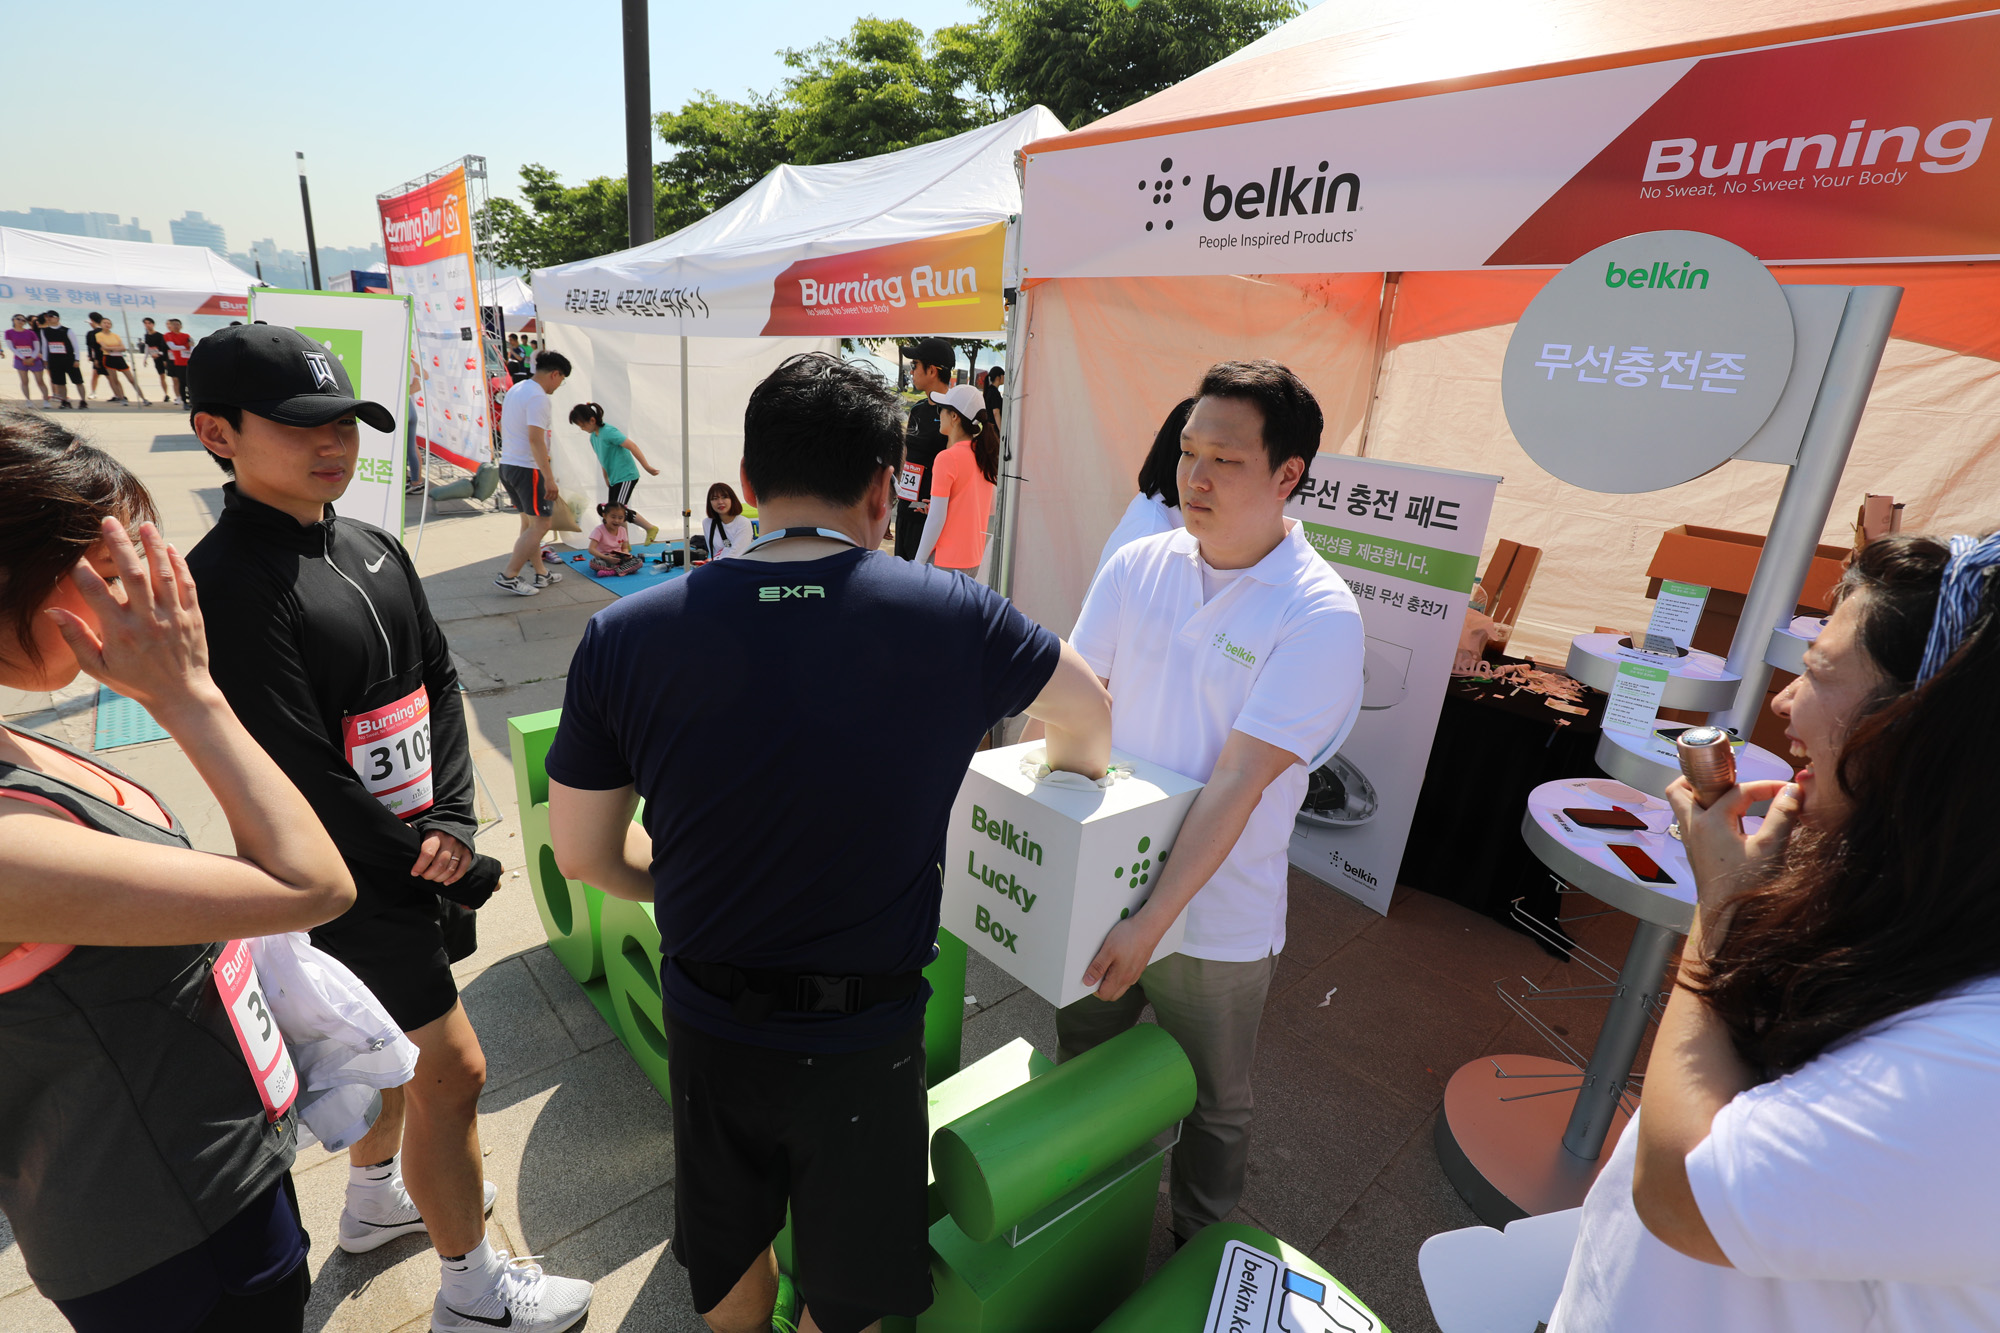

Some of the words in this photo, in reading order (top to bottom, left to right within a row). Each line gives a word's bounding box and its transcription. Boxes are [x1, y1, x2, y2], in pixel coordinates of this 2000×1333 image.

[1642, 118, 1993, 183] Burning
[1202, 160, 1361, 222] belkin
[1640, 186, 1662, 200] No
[1664, 183, 1718, 199] Sweat,
[1723, 181, 1747, 195] No
[1751, 176, 1806, 193] Sweet
[1811, 172, 1854, 189] Your
[1858, 168, 1908, 186] Body
[421, 207, 442, 237] Run
[1199, 233, 1238, 251] People
[1240, 231, 1291, 248] Inspired
[1293, 228, 1355, 245] Products
[798, 273, 907, 308] Burning
[910, 264, 978, 299] Run
[1605, 261, 1710, 290] belkin
[1534, 343, 1747, 394] 무선충전존
[357, 457, 394, 485] 전존
[1297, 477, 1341, 511] 무선
[1347, 483, 1400, 522] 충전
[1404, 495, 1461, 531] 패드
[1355, 543, 1430, 576] 제공합니다.
[758, 585, 826, 601] EXR
[1379, 588, 1405, 608] 무선
[1406, 595, 1449, 620] 충전기
[1225, 640, 1256, 665] belkin
[356, 704, 414, 736] Burning
[971, 804, 1043, 866] Belkin
[967, 850, 1037, 914] Lucky
[1344, 860, 1377, 886] belkin
[974, 904, 1018, 955] Box
